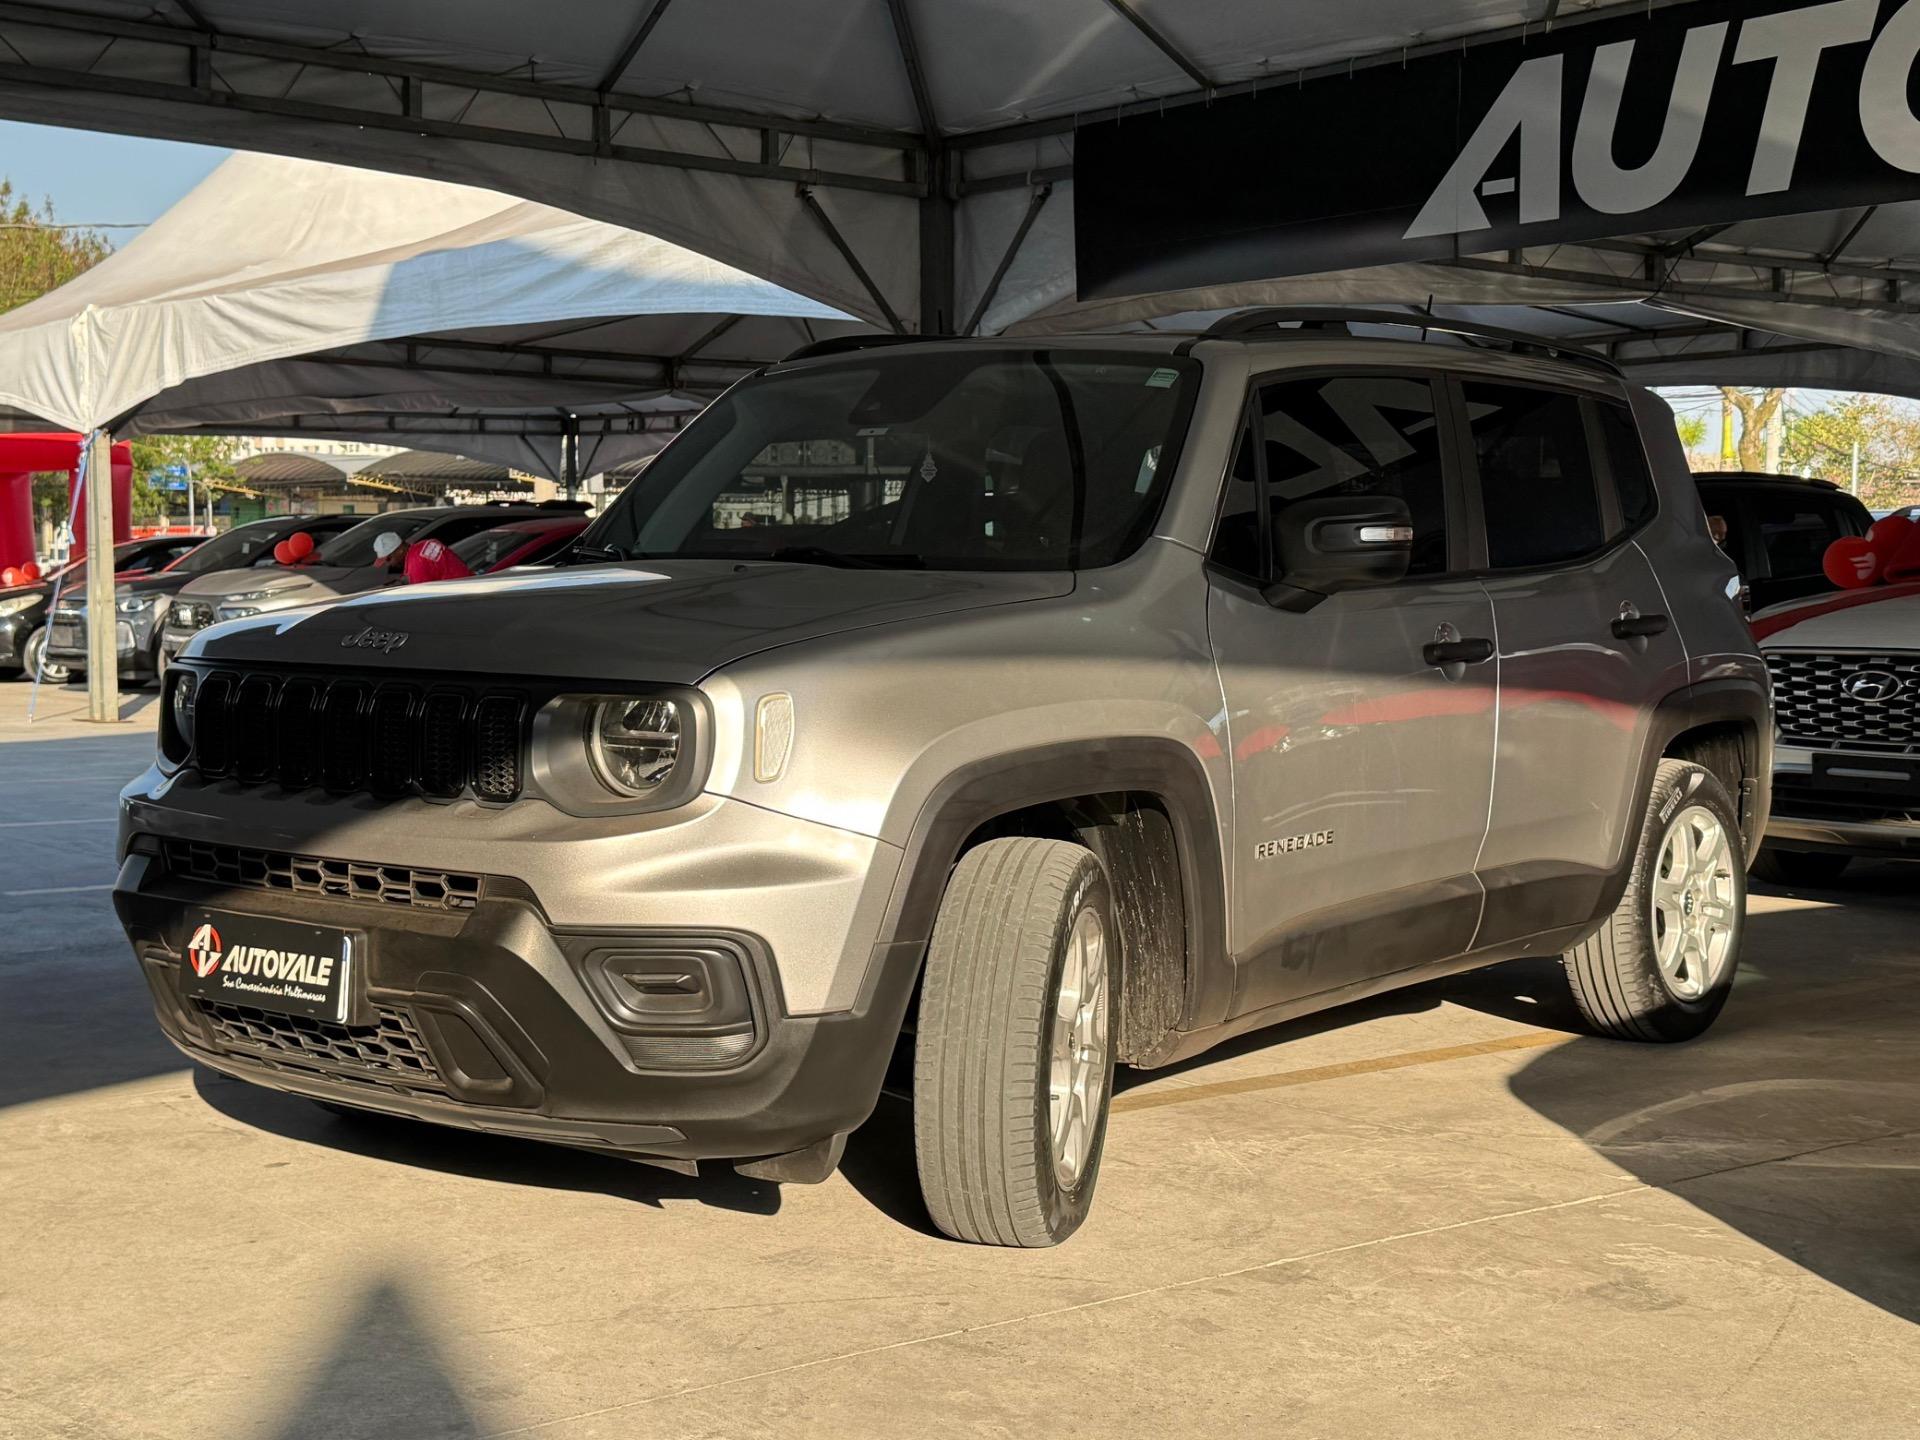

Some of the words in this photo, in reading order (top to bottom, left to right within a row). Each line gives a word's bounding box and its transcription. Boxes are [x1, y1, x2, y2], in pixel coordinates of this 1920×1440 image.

[341, 626, 409, 654] Jeep
[1255, 830, 1334, 860] RENEGADE
[221, 945, 334, 986] AUTOVALE
